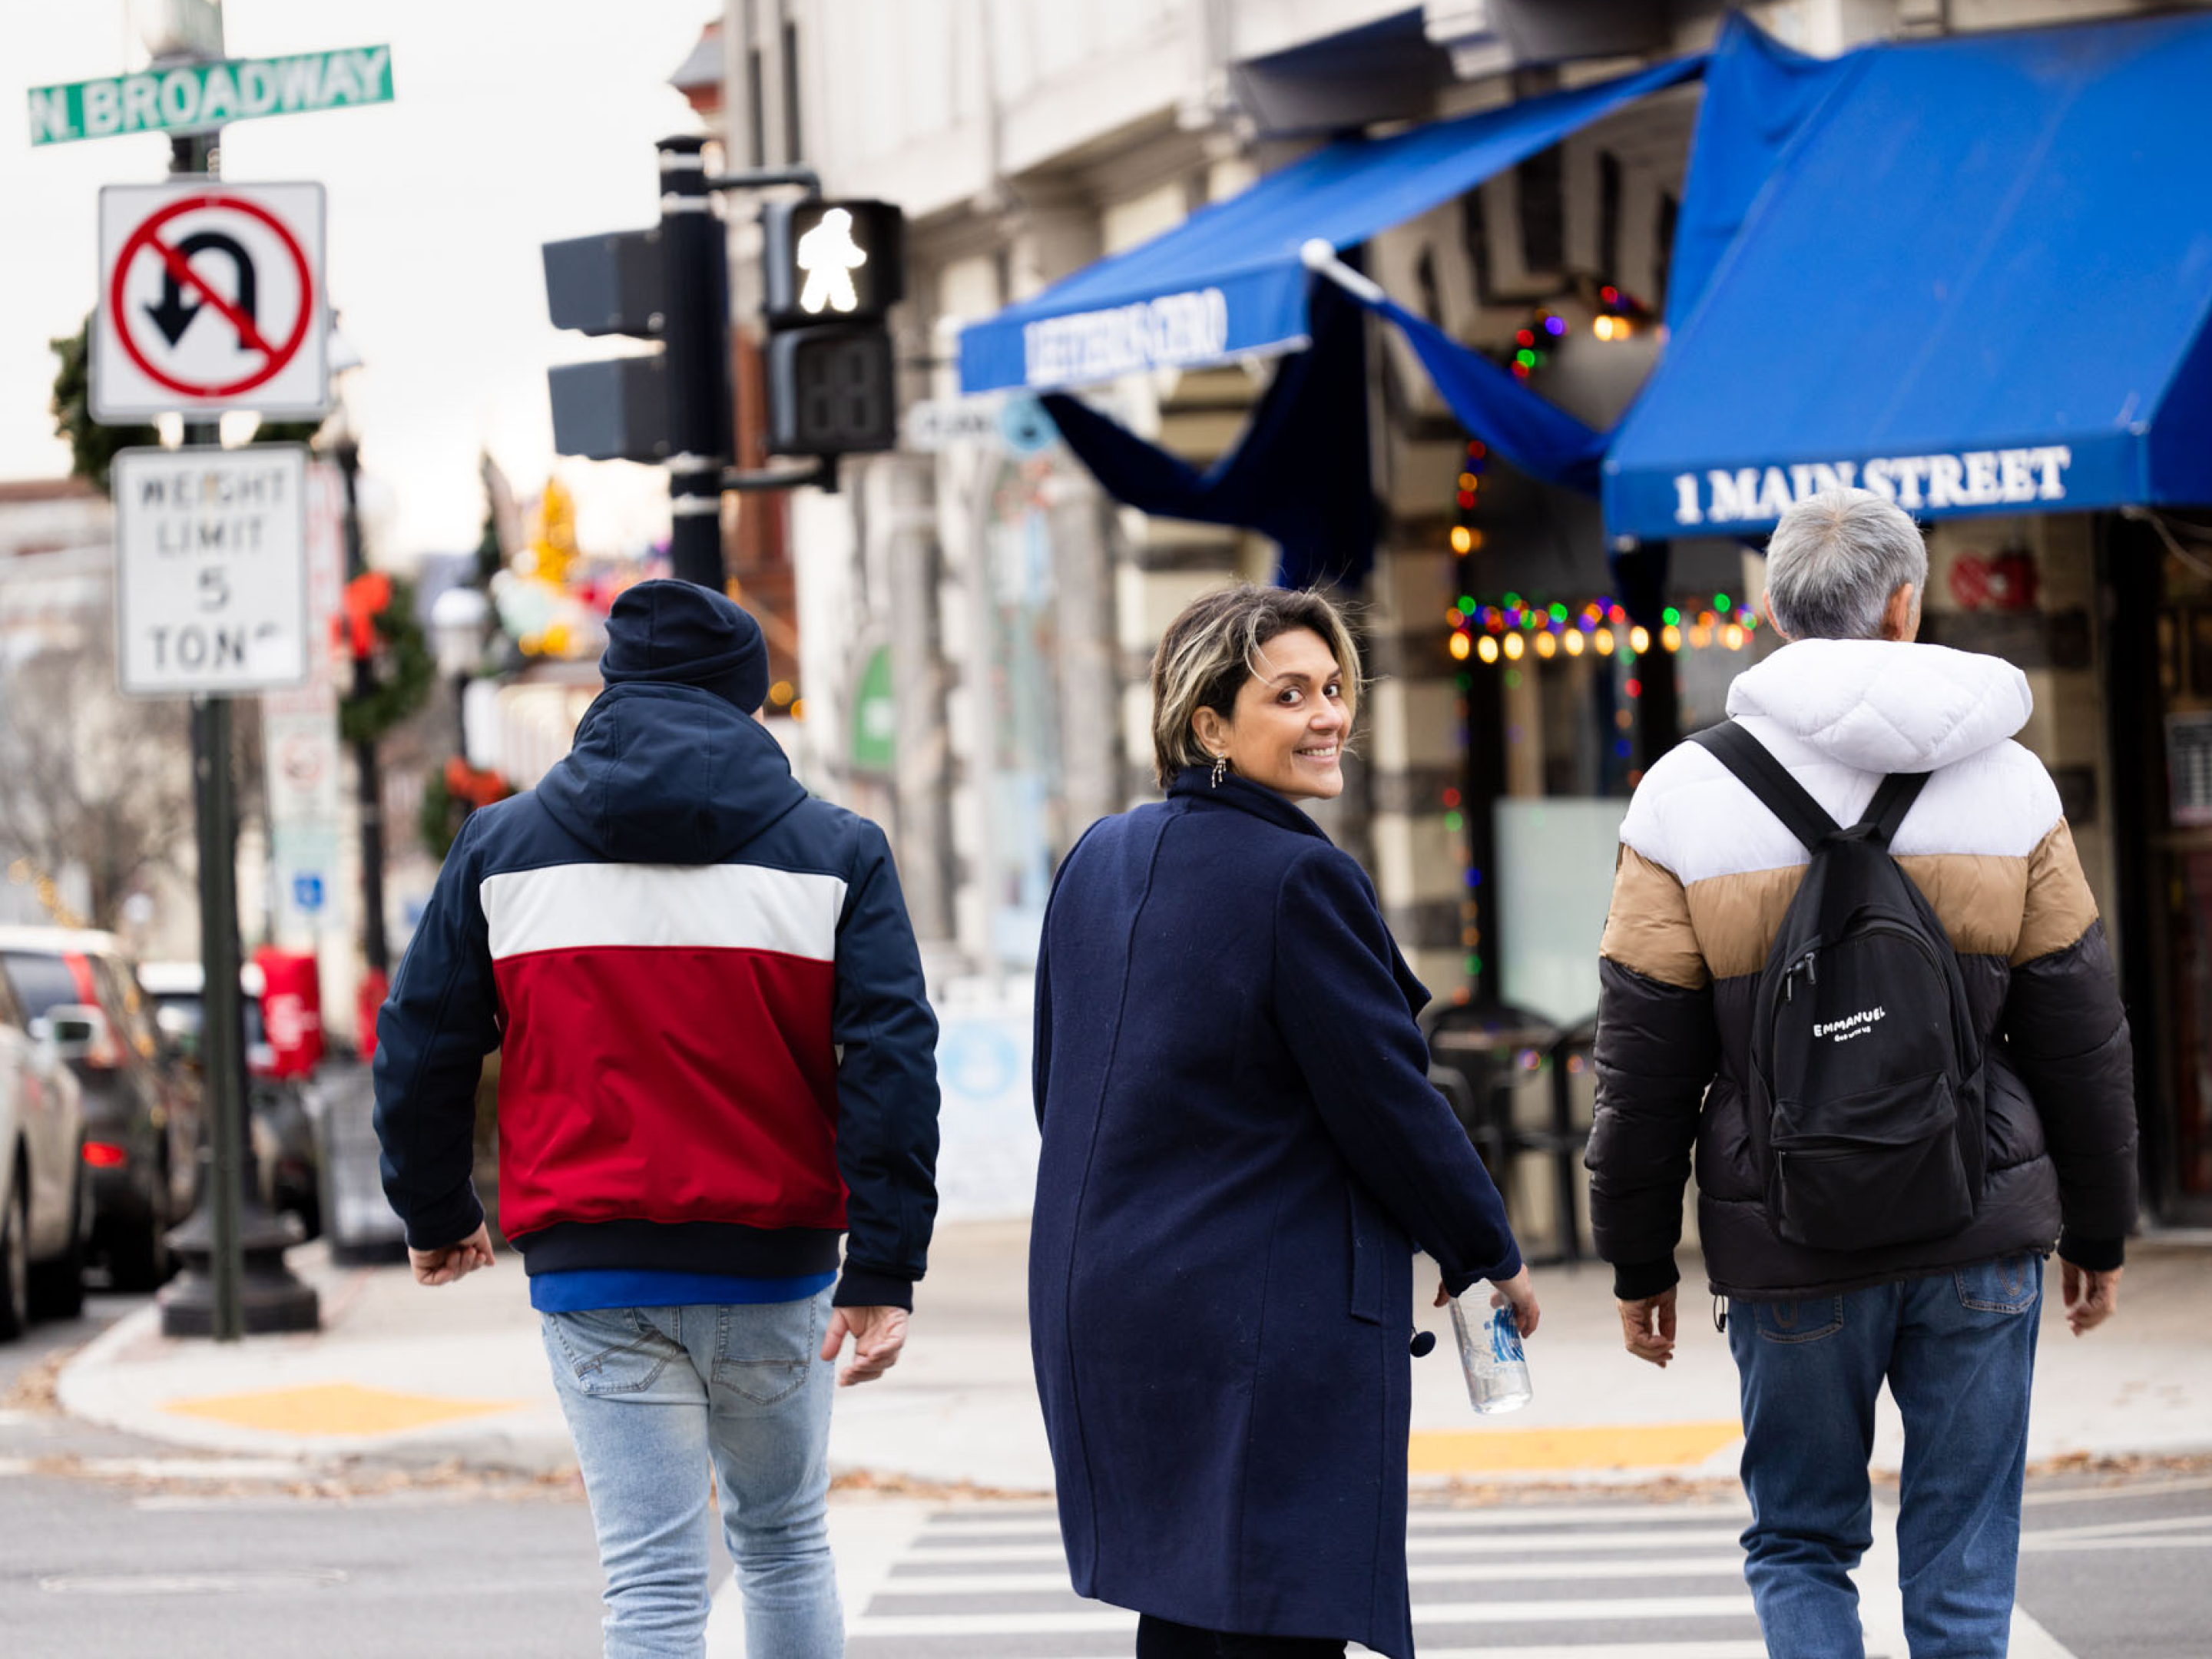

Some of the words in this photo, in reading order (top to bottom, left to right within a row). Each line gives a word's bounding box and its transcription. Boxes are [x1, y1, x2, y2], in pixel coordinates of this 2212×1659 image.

[81, 46, 389, 135] BROADWAY
[140, 468, 286, 508] WEIGHT
[1674, 473, 1703, 525] 1
[1864, 445, 2071, 509] STREET
[157, 514, 263, 558] LIMIT
[197, 565, 231, 614] 5
[1813, 1005, 1886, 1037] EMMANUEL
